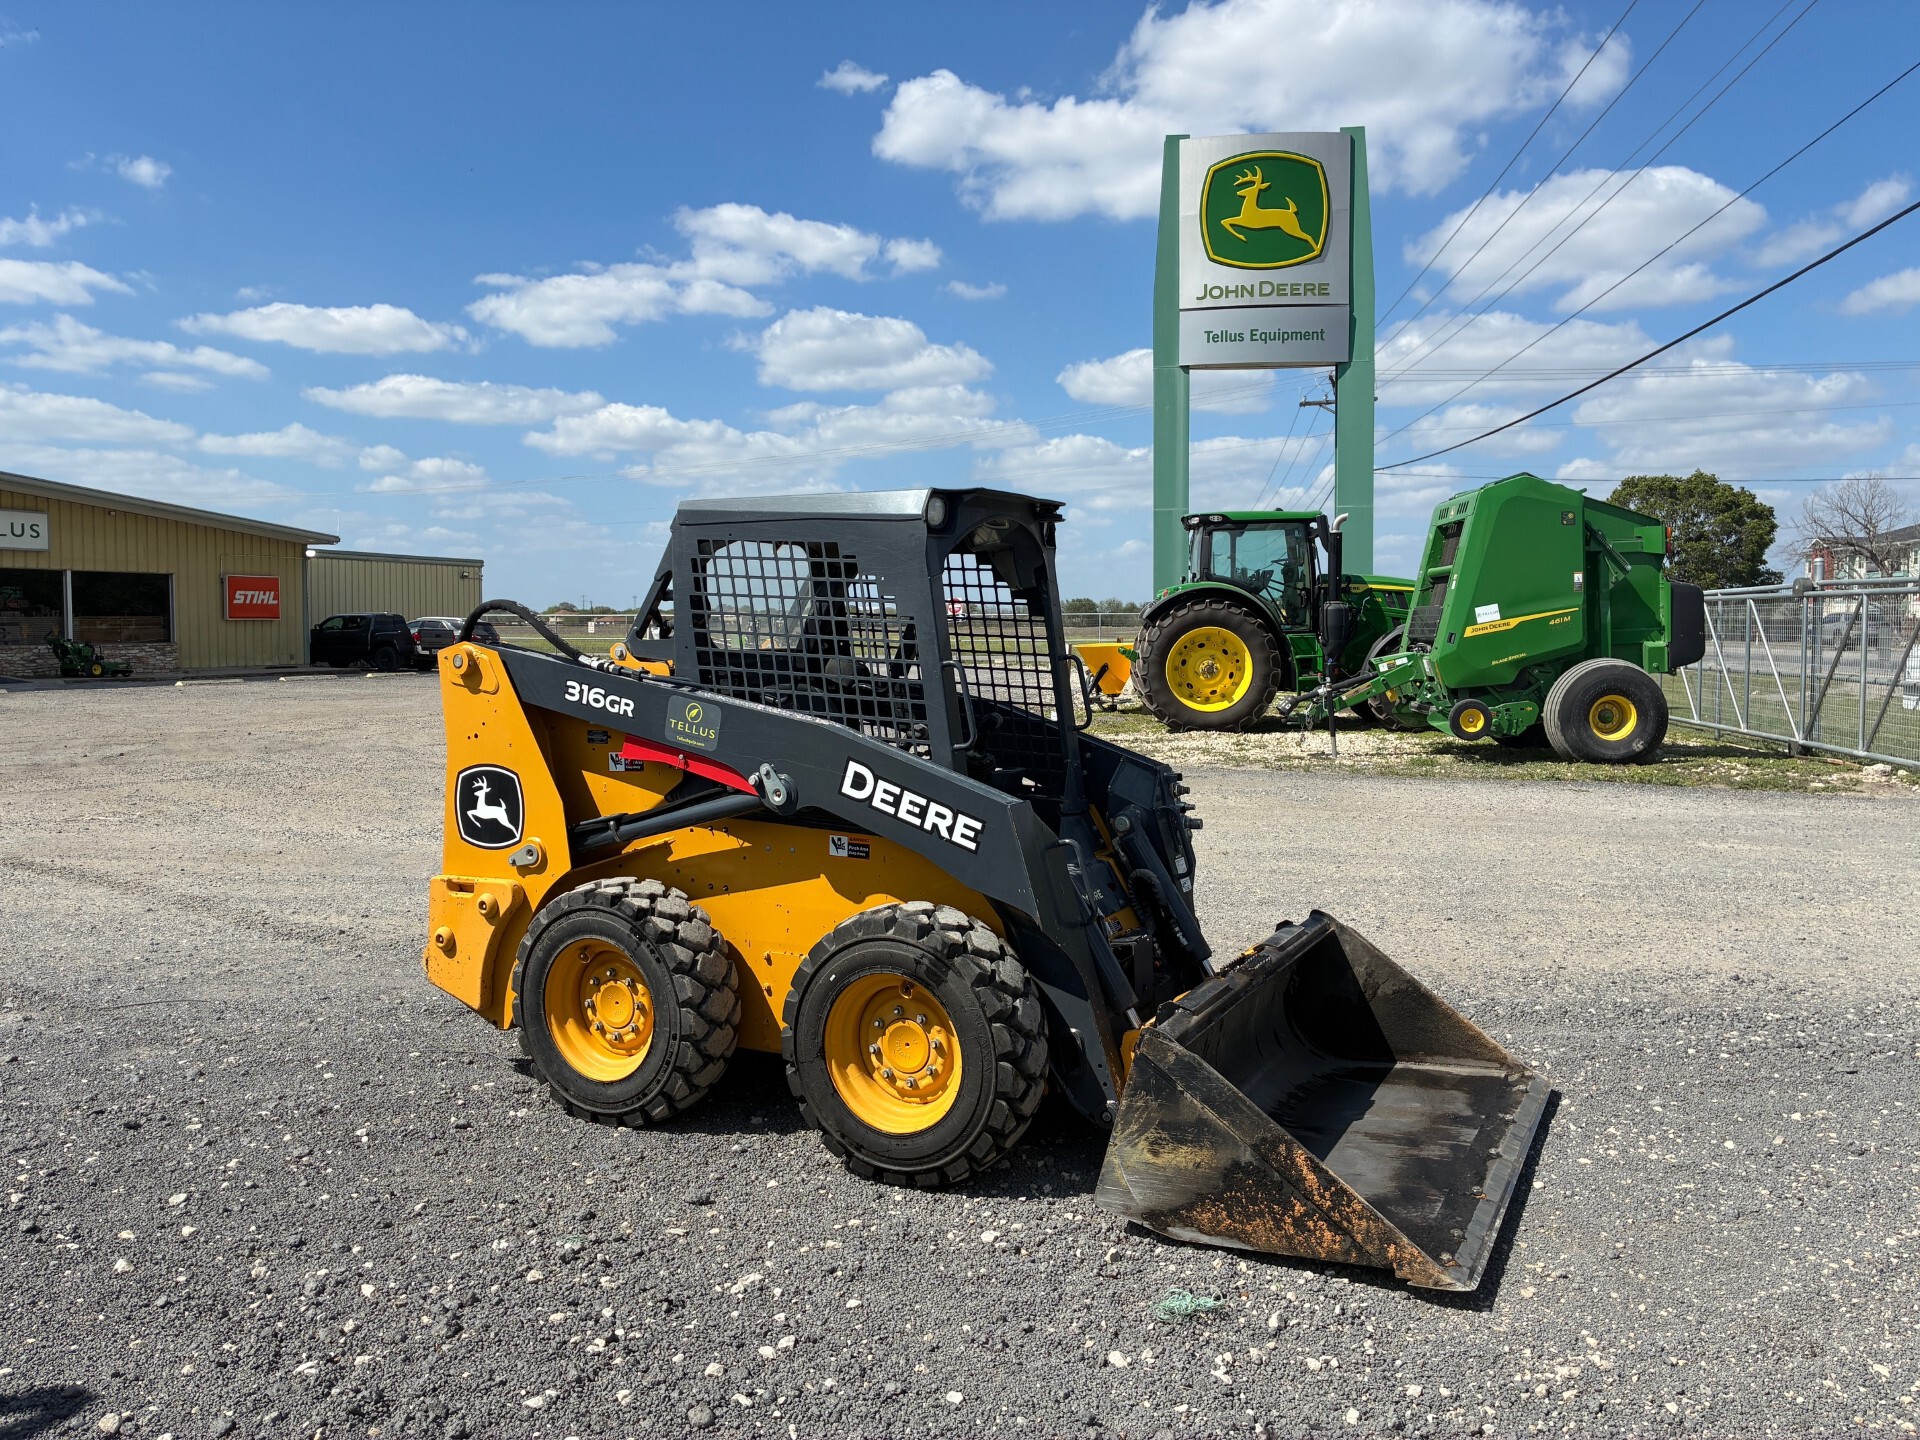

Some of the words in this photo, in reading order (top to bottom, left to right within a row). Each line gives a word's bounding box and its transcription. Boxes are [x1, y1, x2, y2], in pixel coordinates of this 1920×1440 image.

[1196, 283, 1255, 300] JOHN
[1258, 280, 1330, 298] DEERE
[1203, 329, 1245, 343] Tellus
[1249, 327, 1326, 345] Equipment
[232, 590, 278, 605] STIHL
[1470, 626, 1489, 634] JOHN
[1488, 621, 1511, 631] DEERE
[564, 680, 635, 718] 316GR
[669, 718, 716, 739] TELLUS
[841, 760, 983, 851] DEERE
